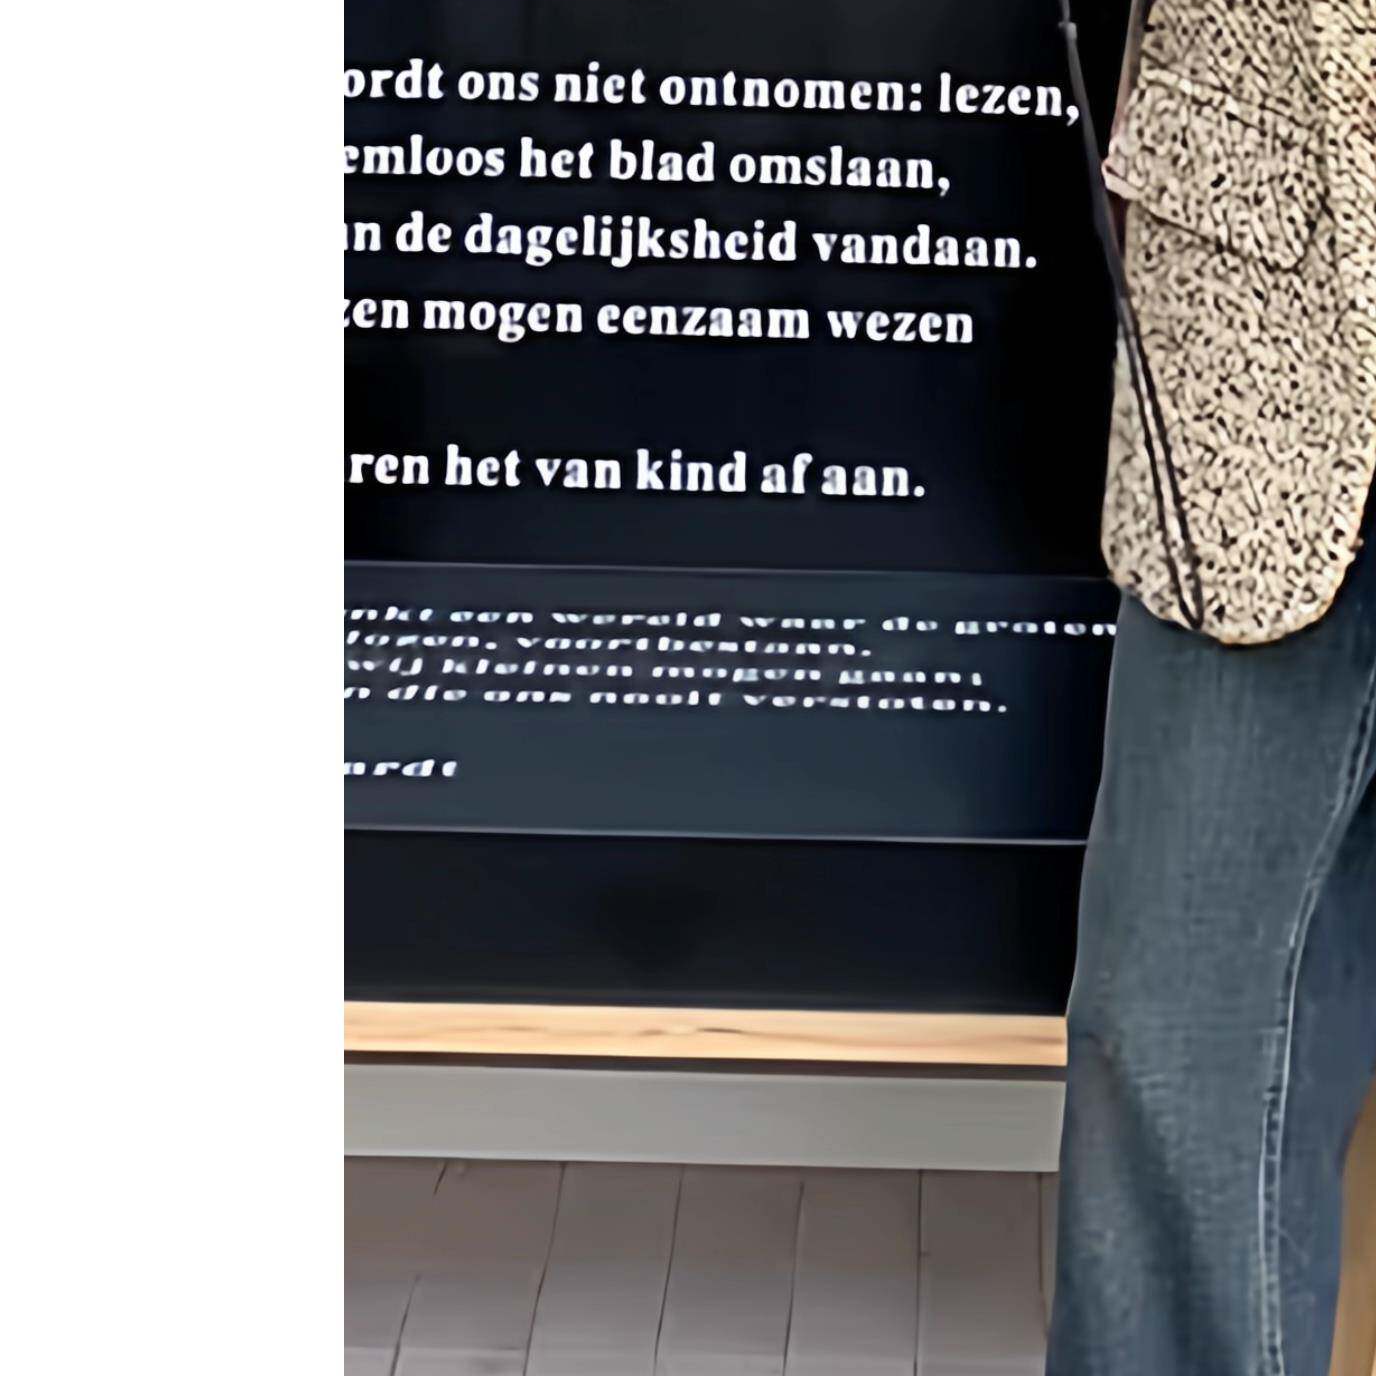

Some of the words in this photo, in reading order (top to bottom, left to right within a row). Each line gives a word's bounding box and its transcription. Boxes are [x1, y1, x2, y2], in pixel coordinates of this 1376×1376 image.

[344, 58, 443, 99] ordt
[458, 71, 539, 101] ons
[554, 61, 645, 103] niet
[660, 71, 921, 111] ontnomen:
[940, 73, 1079, 125] lezen,
[520, 137, 593, 178] het
[610, 139, 714, 182] blad
[730, 146, 949, 196] omslaan,
[396, 211, 451, 252] de
[465, 213, 796, 267] dagelijksheid
[812, 224, 1036, 268] vandaan.
[424, 300, 582, 342] mogen
[597, 305, 809, 338] eenzaam
[827, 311, 972, 343] wezen
[349, 454, 429, 484] ren
[445, 444, 520, 486] het
[536, 459, 621, 489] van
[637, 449, 746, 492] kind
[761, 453, 812, 494] af
[822, 466, 924, 497] aan.
[483, 690, 572, 703] ons
